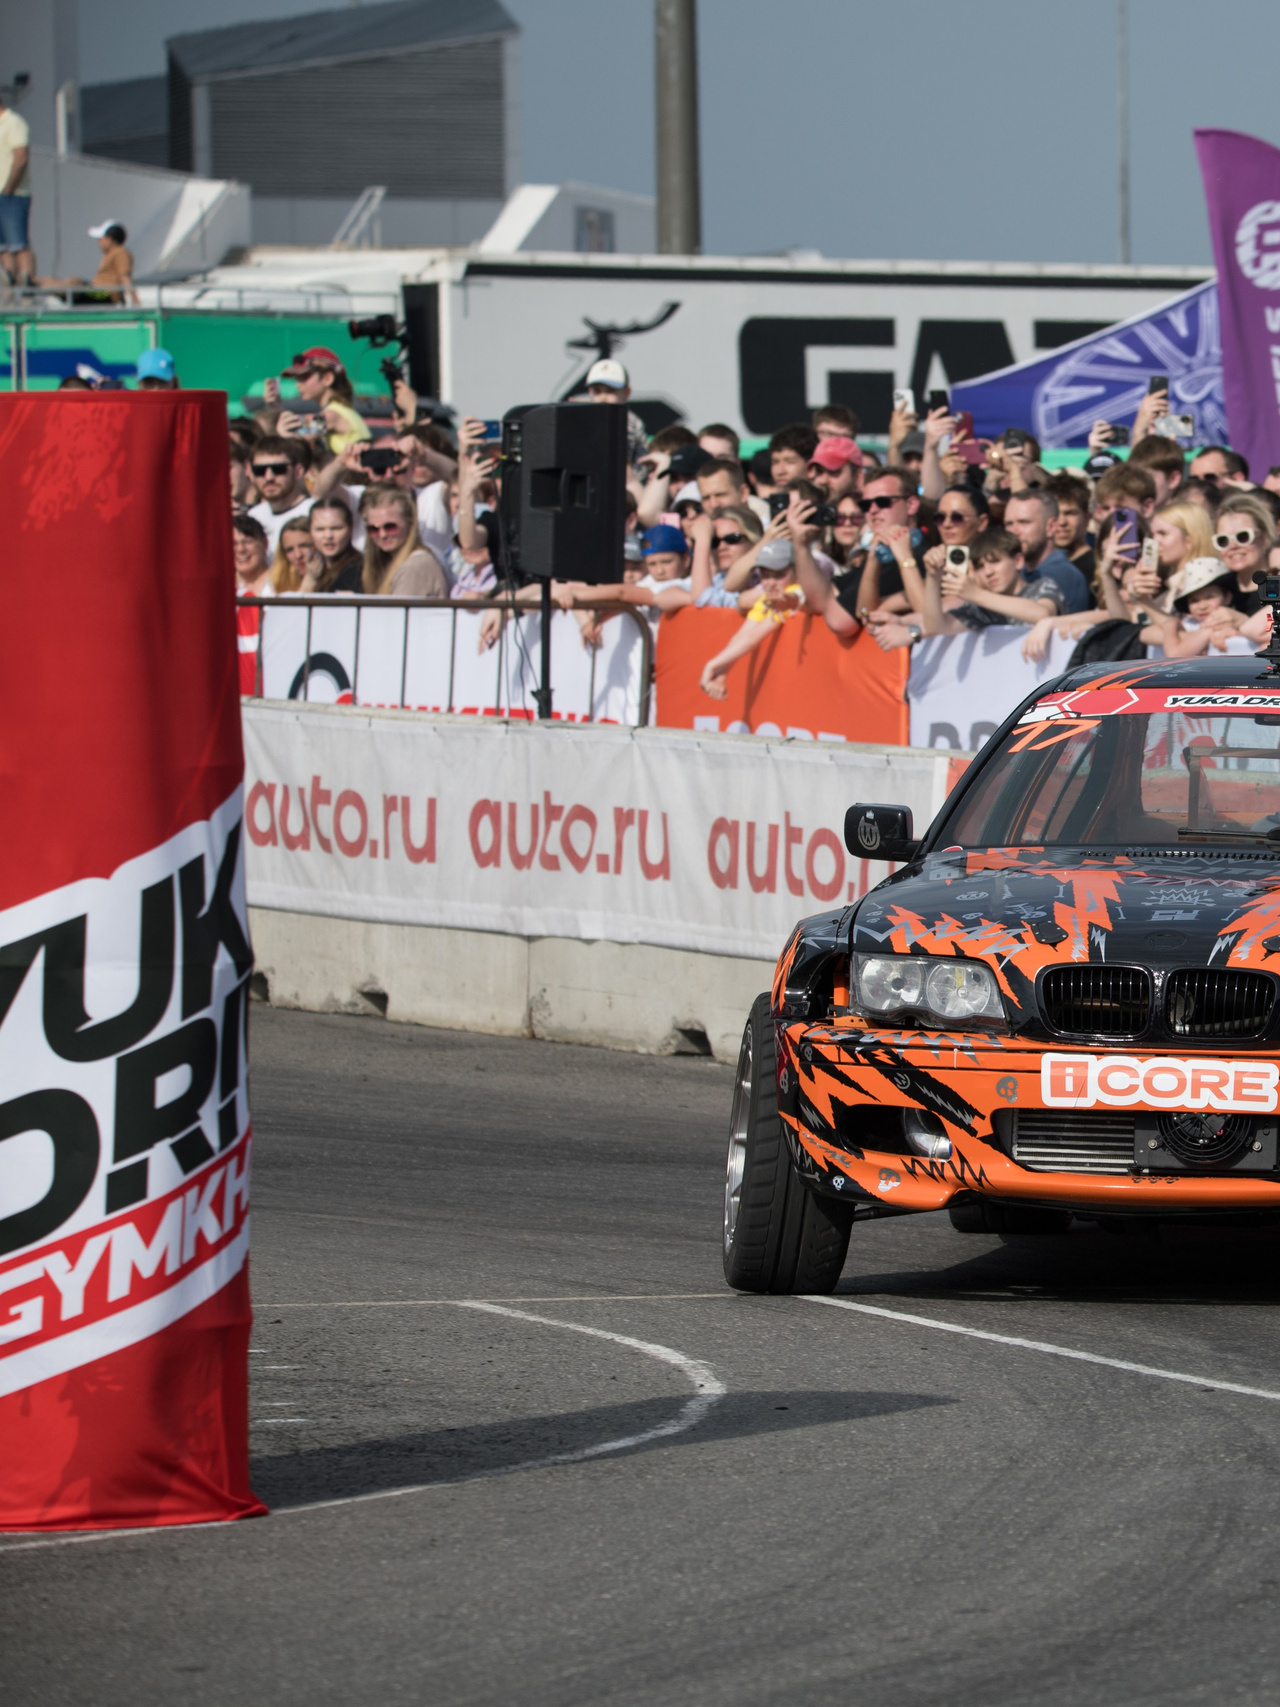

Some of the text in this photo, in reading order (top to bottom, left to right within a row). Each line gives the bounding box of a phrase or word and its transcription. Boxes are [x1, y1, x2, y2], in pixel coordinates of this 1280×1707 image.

[1168, 694, 1239, 707] YUKA
[1007, 718, 1103, 753] 17
[245, 774, 437, 865] auto.ru
[468, 789, 671, 882] auto.ru
